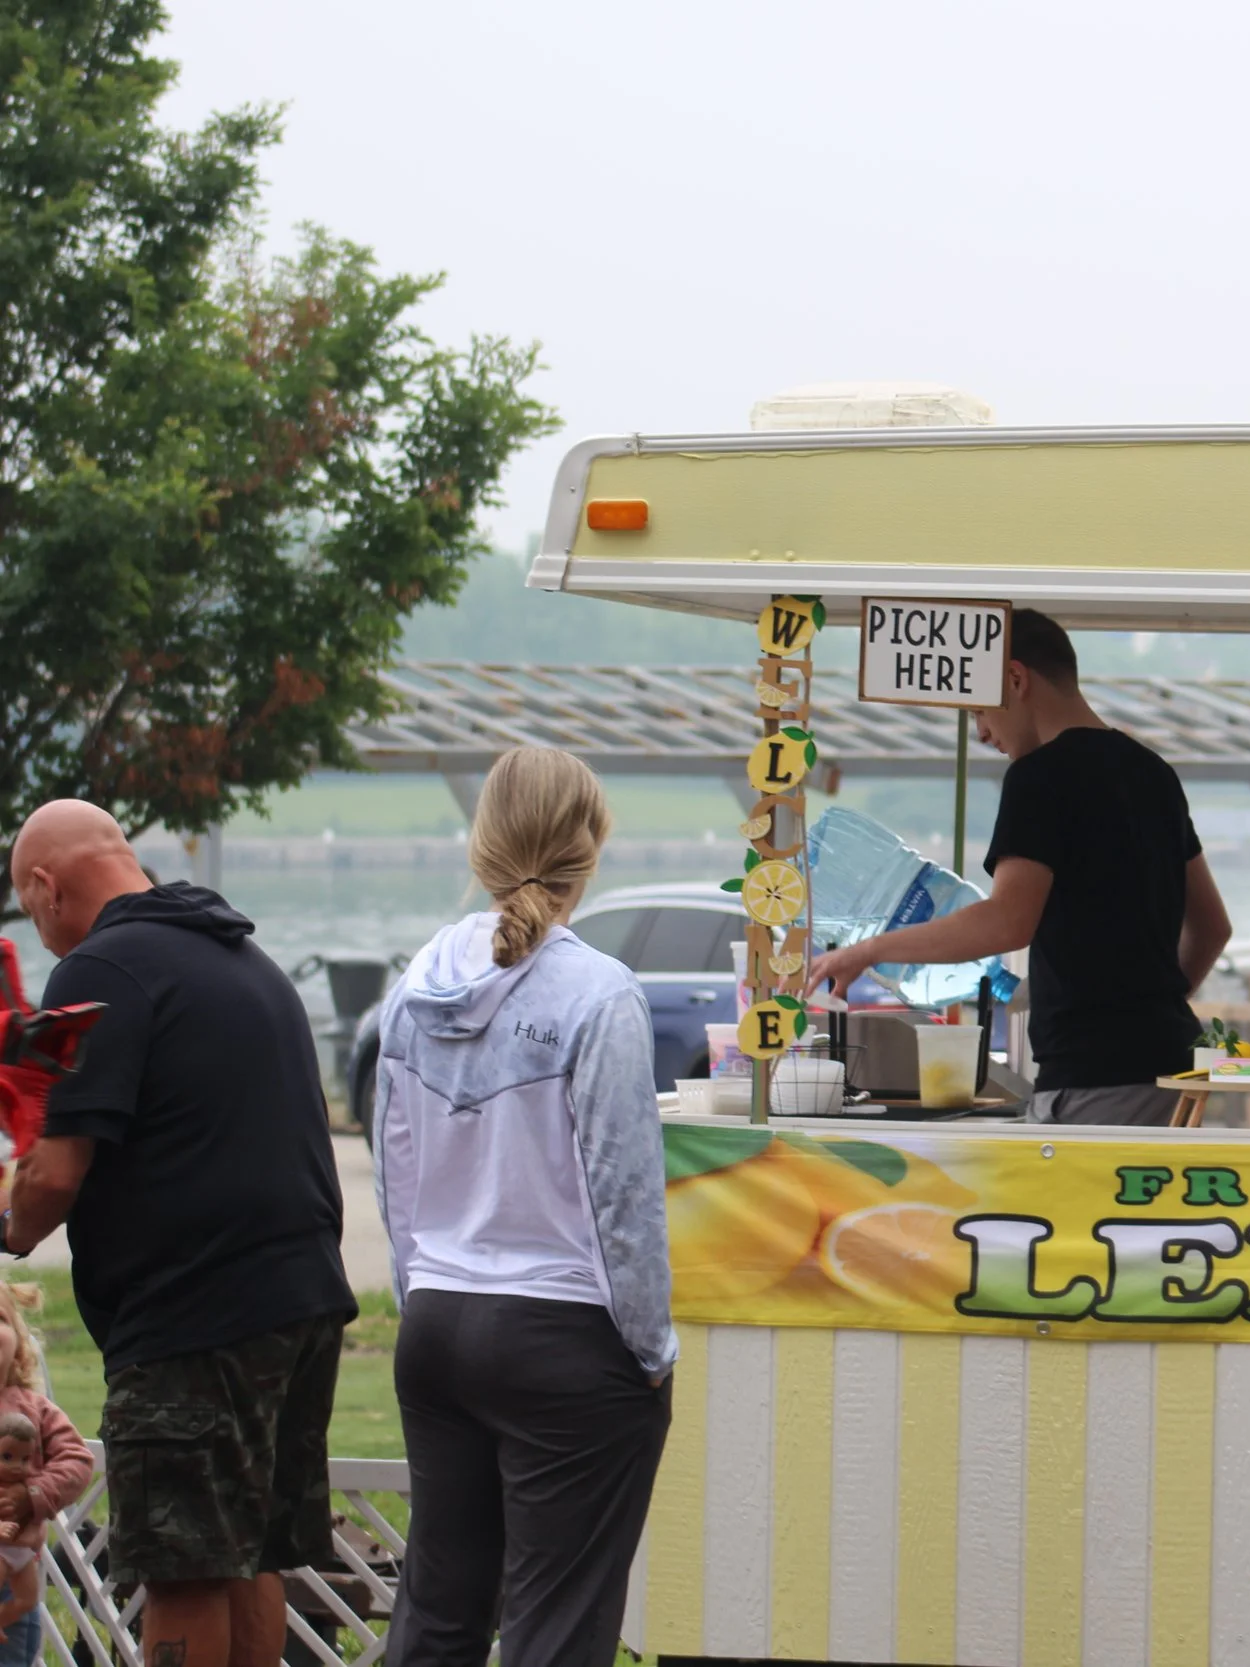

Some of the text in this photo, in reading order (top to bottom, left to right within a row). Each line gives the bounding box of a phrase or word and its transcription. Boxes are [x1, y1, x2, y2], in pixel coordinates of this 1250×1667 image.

[869, 605, 1002, 651] PICK UP
[895, 652, 973, 694] HERE
